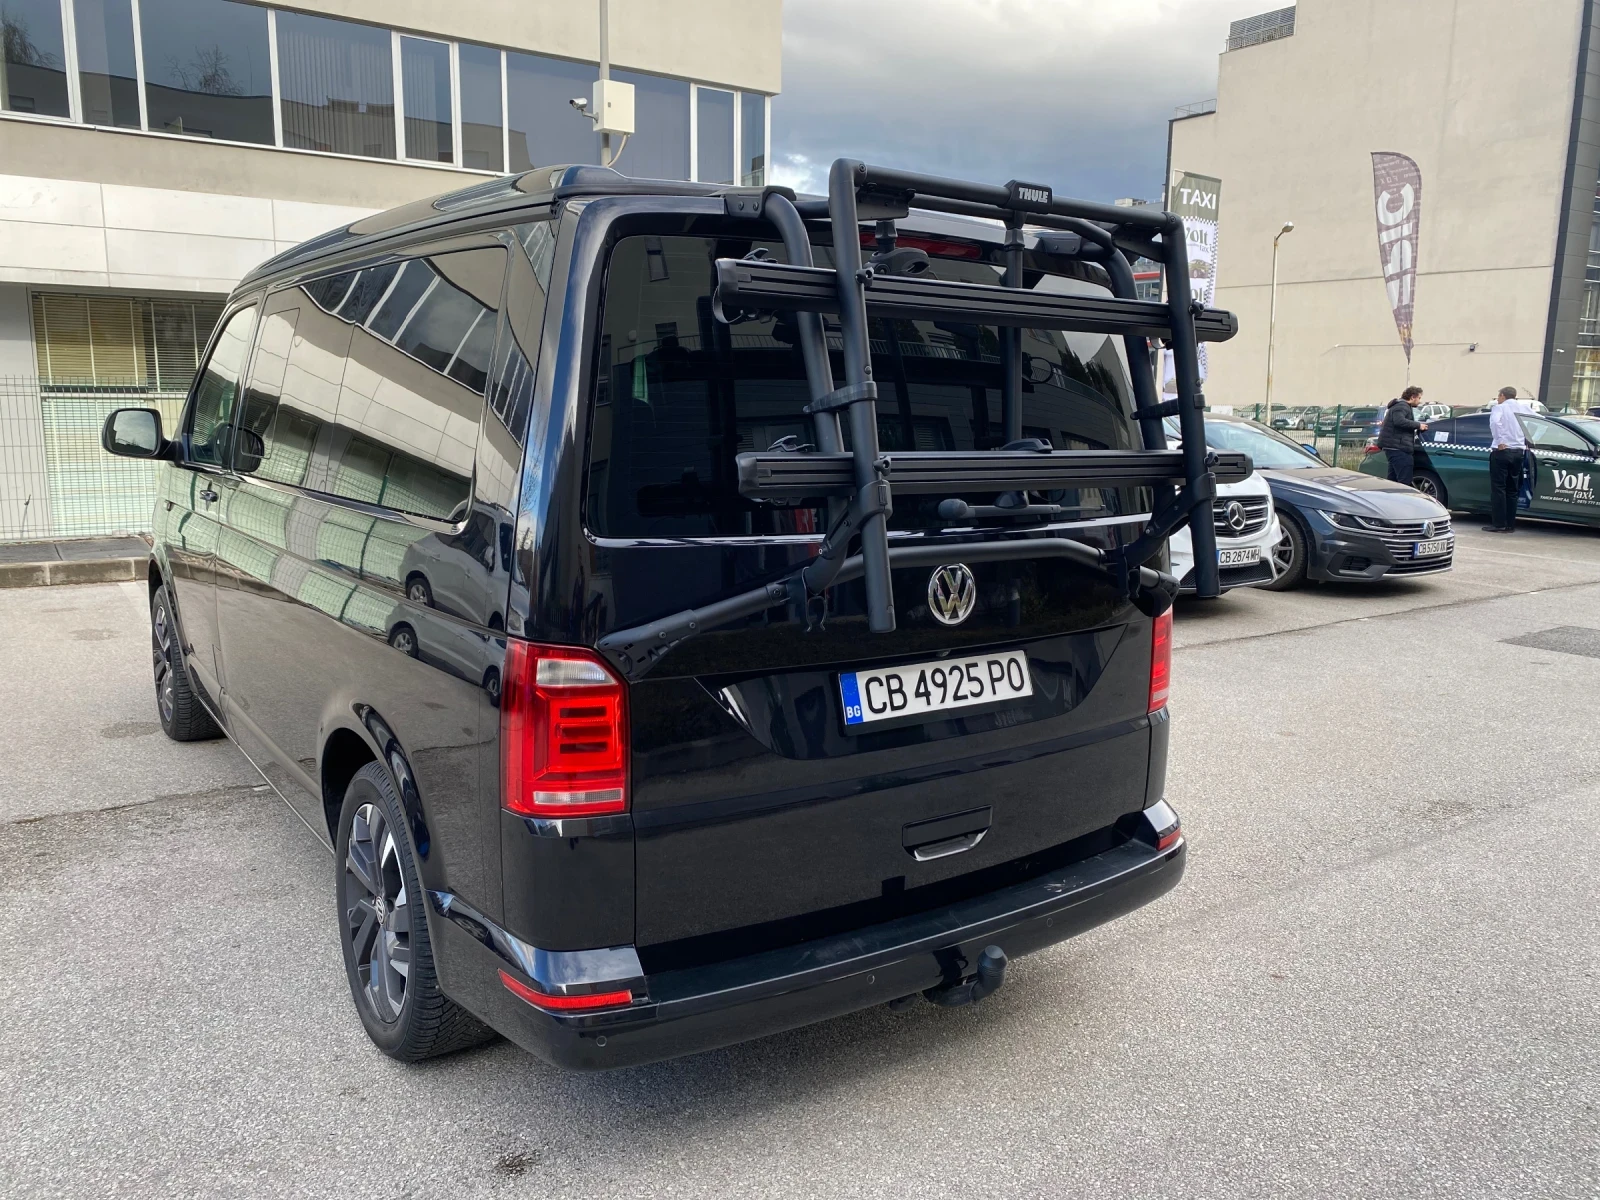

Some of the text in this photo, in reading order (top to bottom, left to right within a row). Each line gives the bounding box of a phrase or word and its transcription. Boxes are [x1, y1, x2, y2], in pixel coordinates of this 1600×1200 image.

[1019, 187, 1048, 203] THULE
[1180, 188, 1217, 210] TAXI
[1552, 470, 1591, 490] Volt
[1220, 551, 1231, 563] CB
[1232, 550, 1250, 562] 2874
[865, 658, 1024, 714] CB 4925 PO
[846, 705, 861, 719] BG
